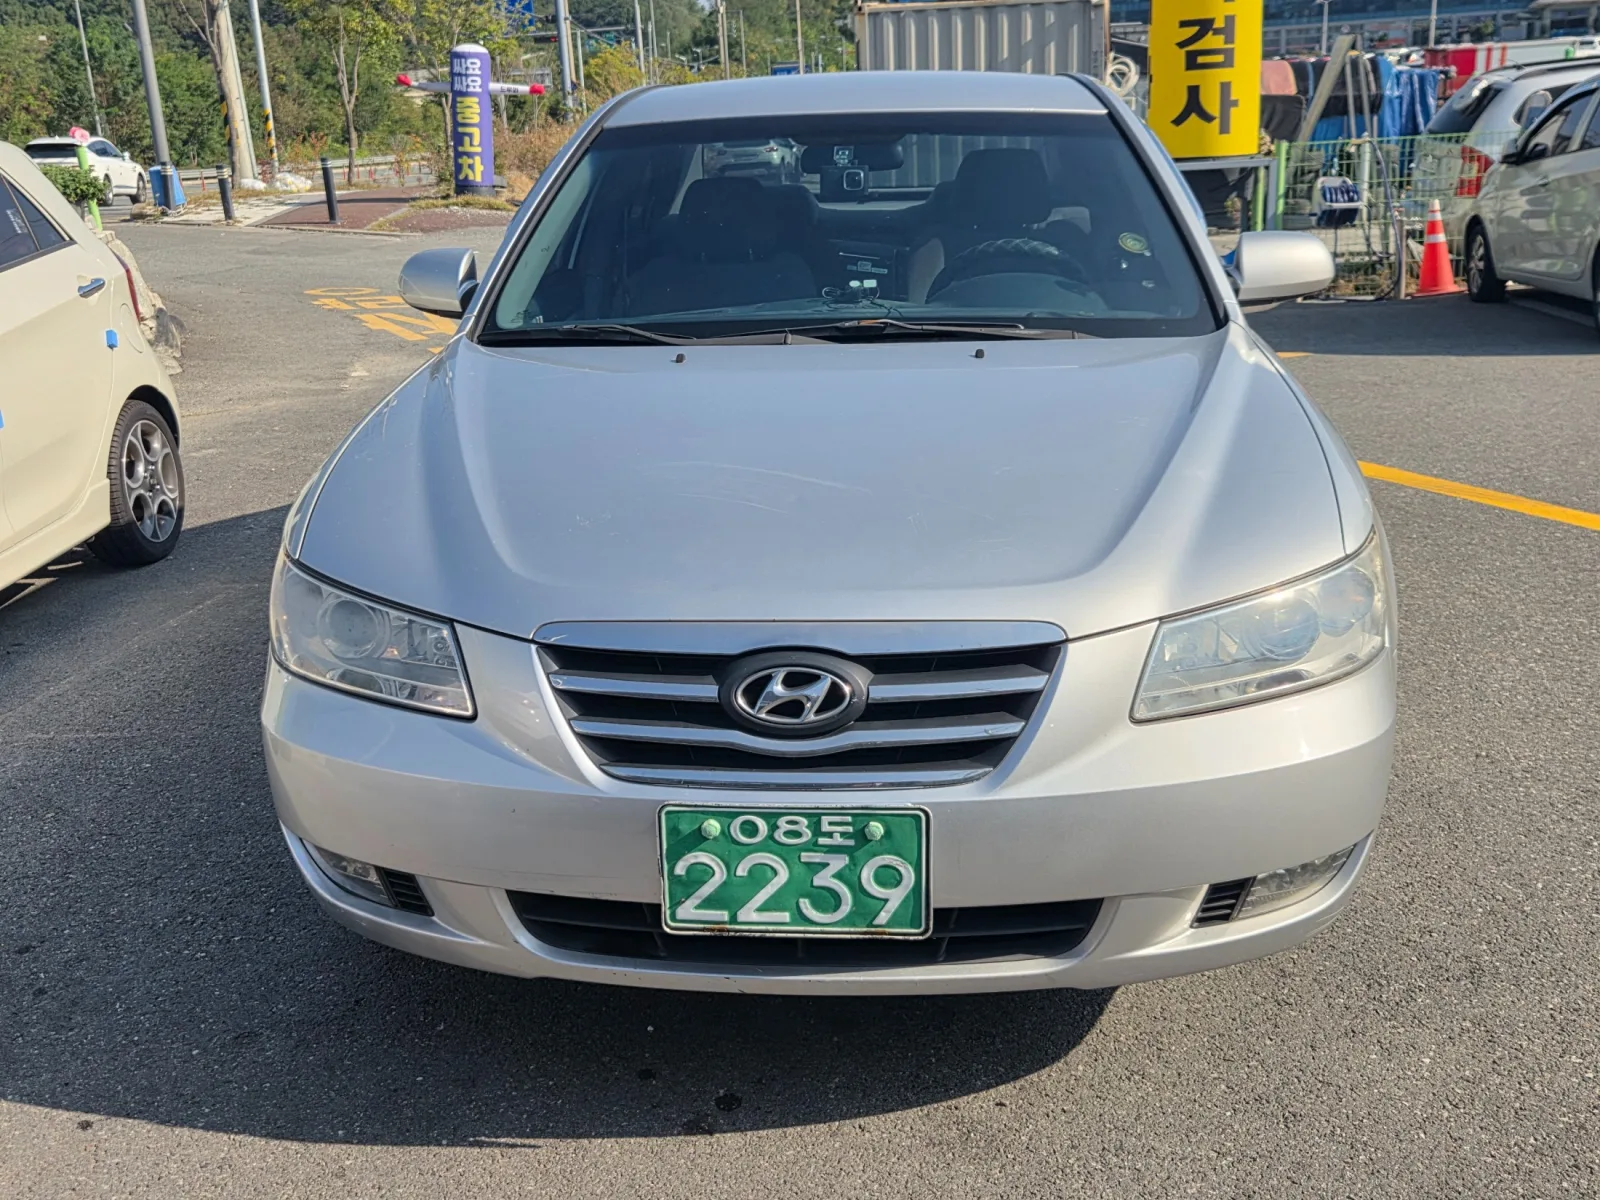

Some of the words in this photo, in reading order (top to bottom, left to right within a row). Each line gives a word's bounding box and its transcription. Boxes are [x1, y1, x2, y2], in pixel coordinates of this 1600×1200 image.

[453, 58, 482, 75] 싸요
[454, 76, 482, 92] 싸요
[456, 96, 484, 182] 중고차
[730, 815, 855, 846] 08도
[673, 852, 915, 926] 2239
